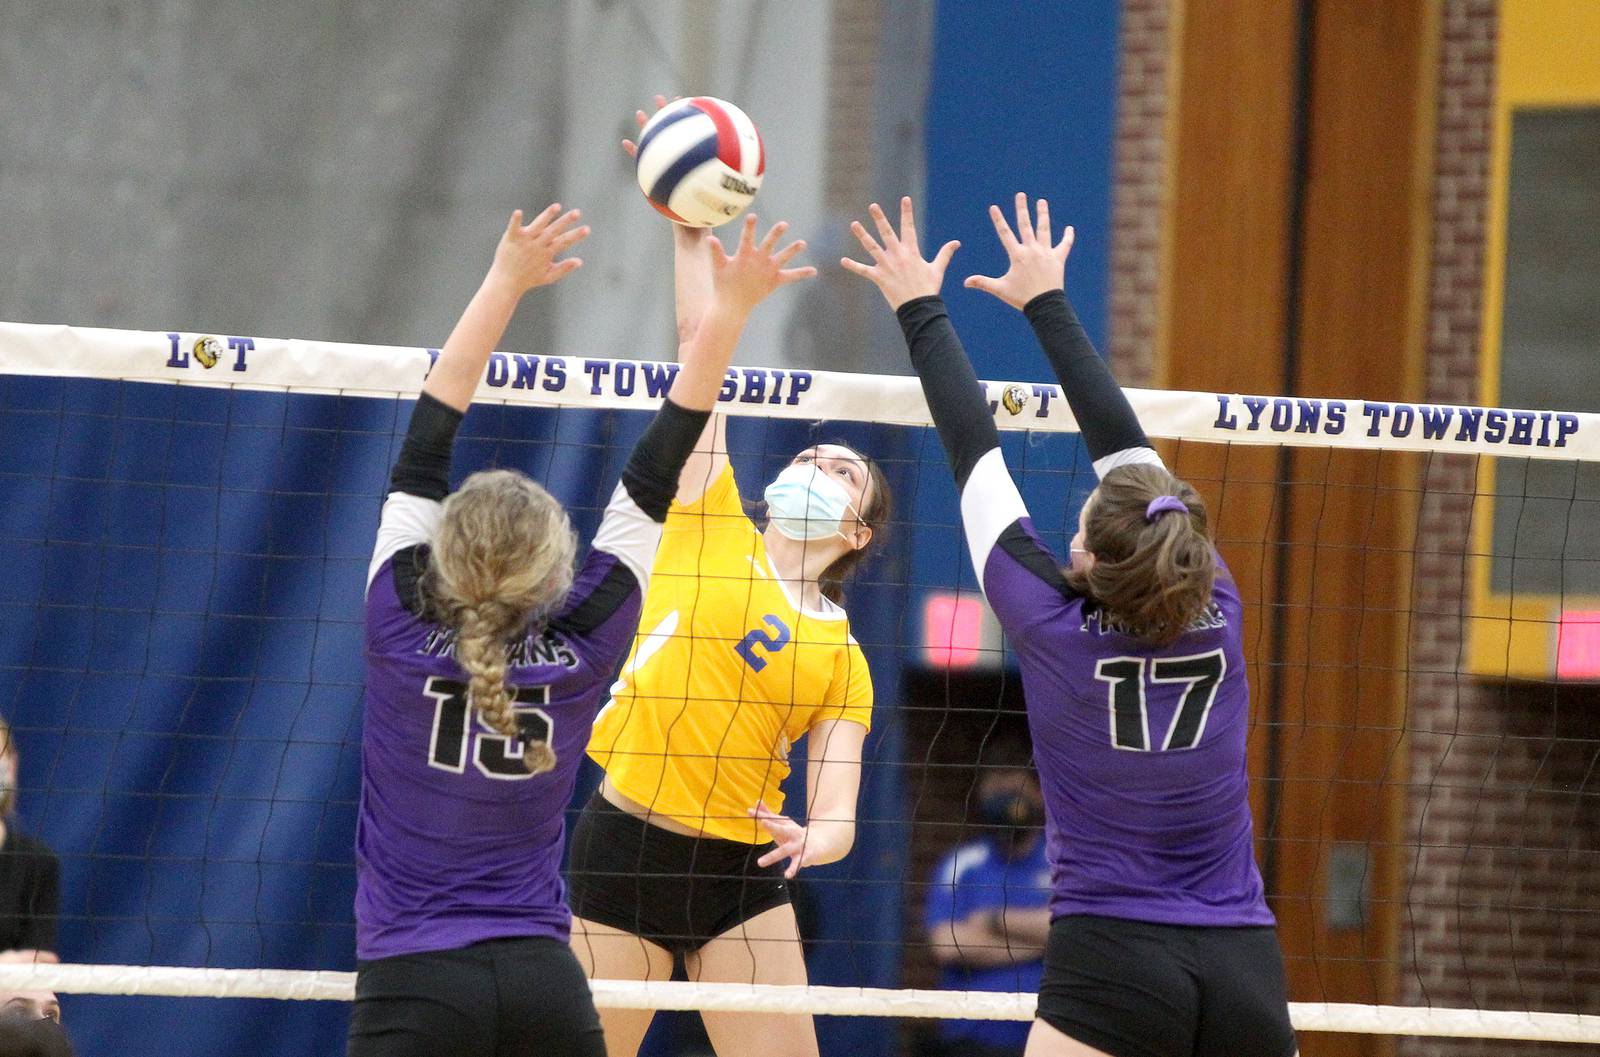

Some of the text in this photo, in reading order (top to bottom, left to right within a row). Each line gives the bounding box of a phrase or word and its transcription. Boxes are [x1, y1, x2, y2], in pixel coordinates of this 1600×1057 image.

[424, 349, 812, 405] ONS TOWSHIP
[1214, 395, 1580, 448] LYONS TOWNSHIP
[734, 614, 791, 673] 2
[423, 675, 555, 780] 15
[1094, 648, 1228, 752] 17
